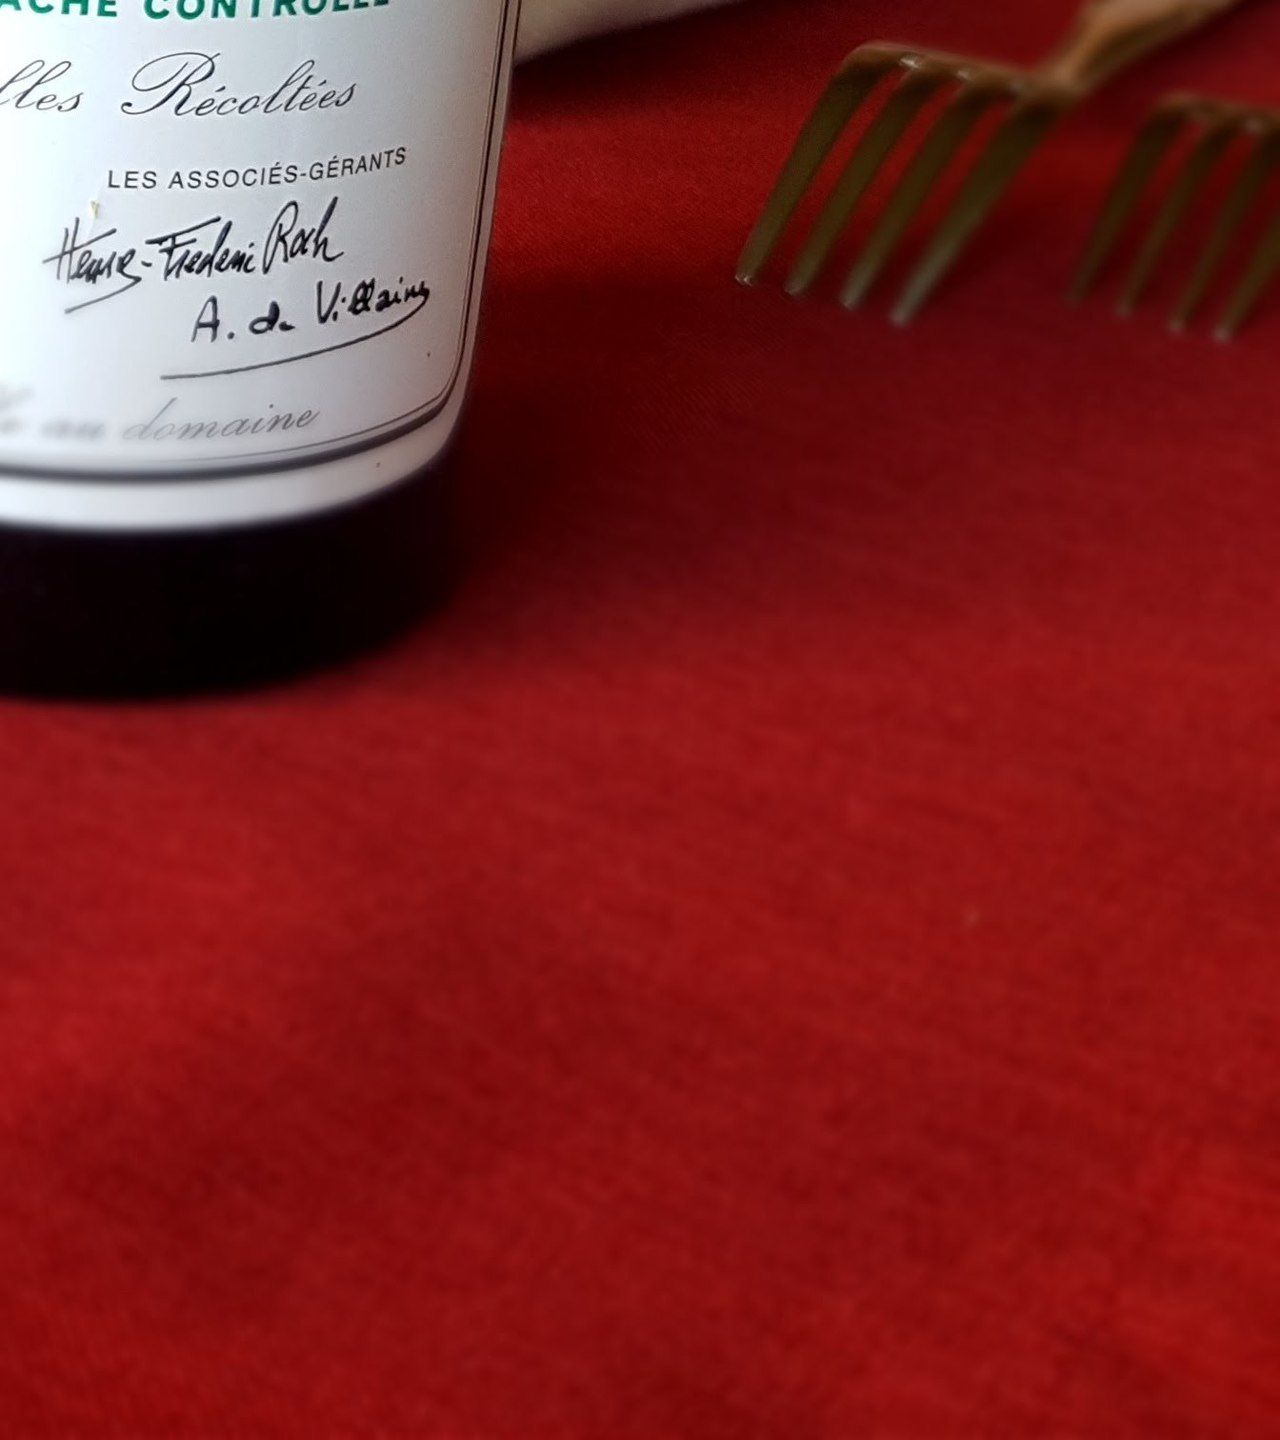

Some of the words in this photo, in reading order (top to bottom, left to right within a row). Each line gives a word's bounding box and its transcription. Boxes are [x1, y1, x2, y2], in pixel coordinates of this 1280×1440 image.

[121, 51, 356, 118] Récoltées
[107, 169, 158, 190] LES
[168, 146, 408, 191] ASSOCIÉS-GÉRANTS
[123, 397, 321, 442] domaine
